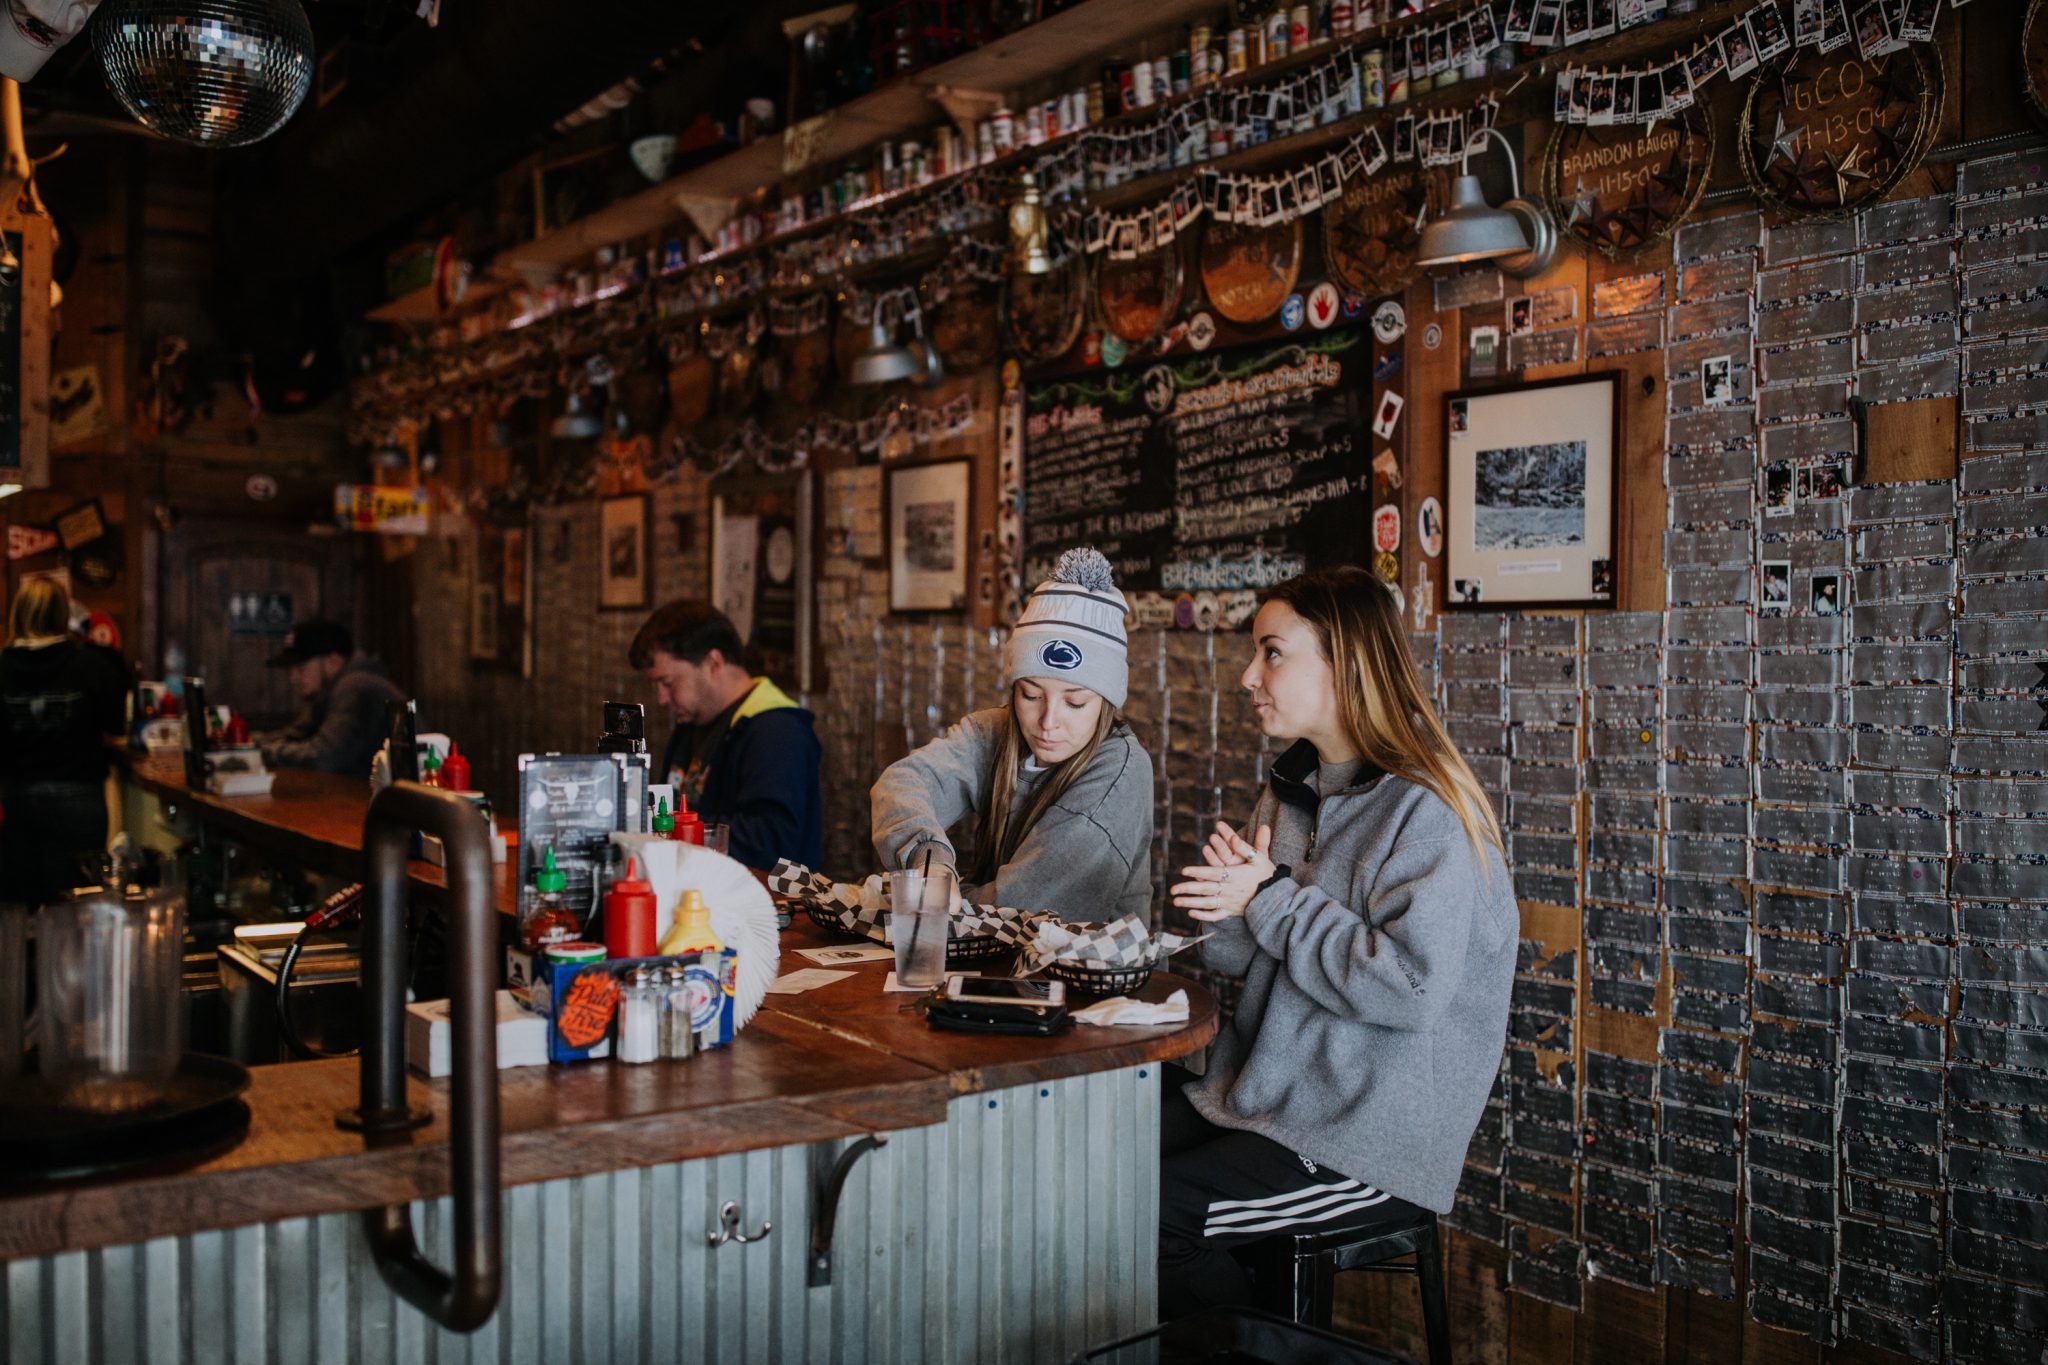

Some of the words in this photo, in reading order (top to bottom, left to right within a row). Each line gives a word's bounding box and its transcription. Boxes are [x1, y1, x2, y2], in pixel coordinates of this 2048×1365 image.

[1562, 141, 1634, 178] BRANDON
[1636, 129, 1681, 159] BAUGH
[1081, 599, 1121, 634] LIONS
